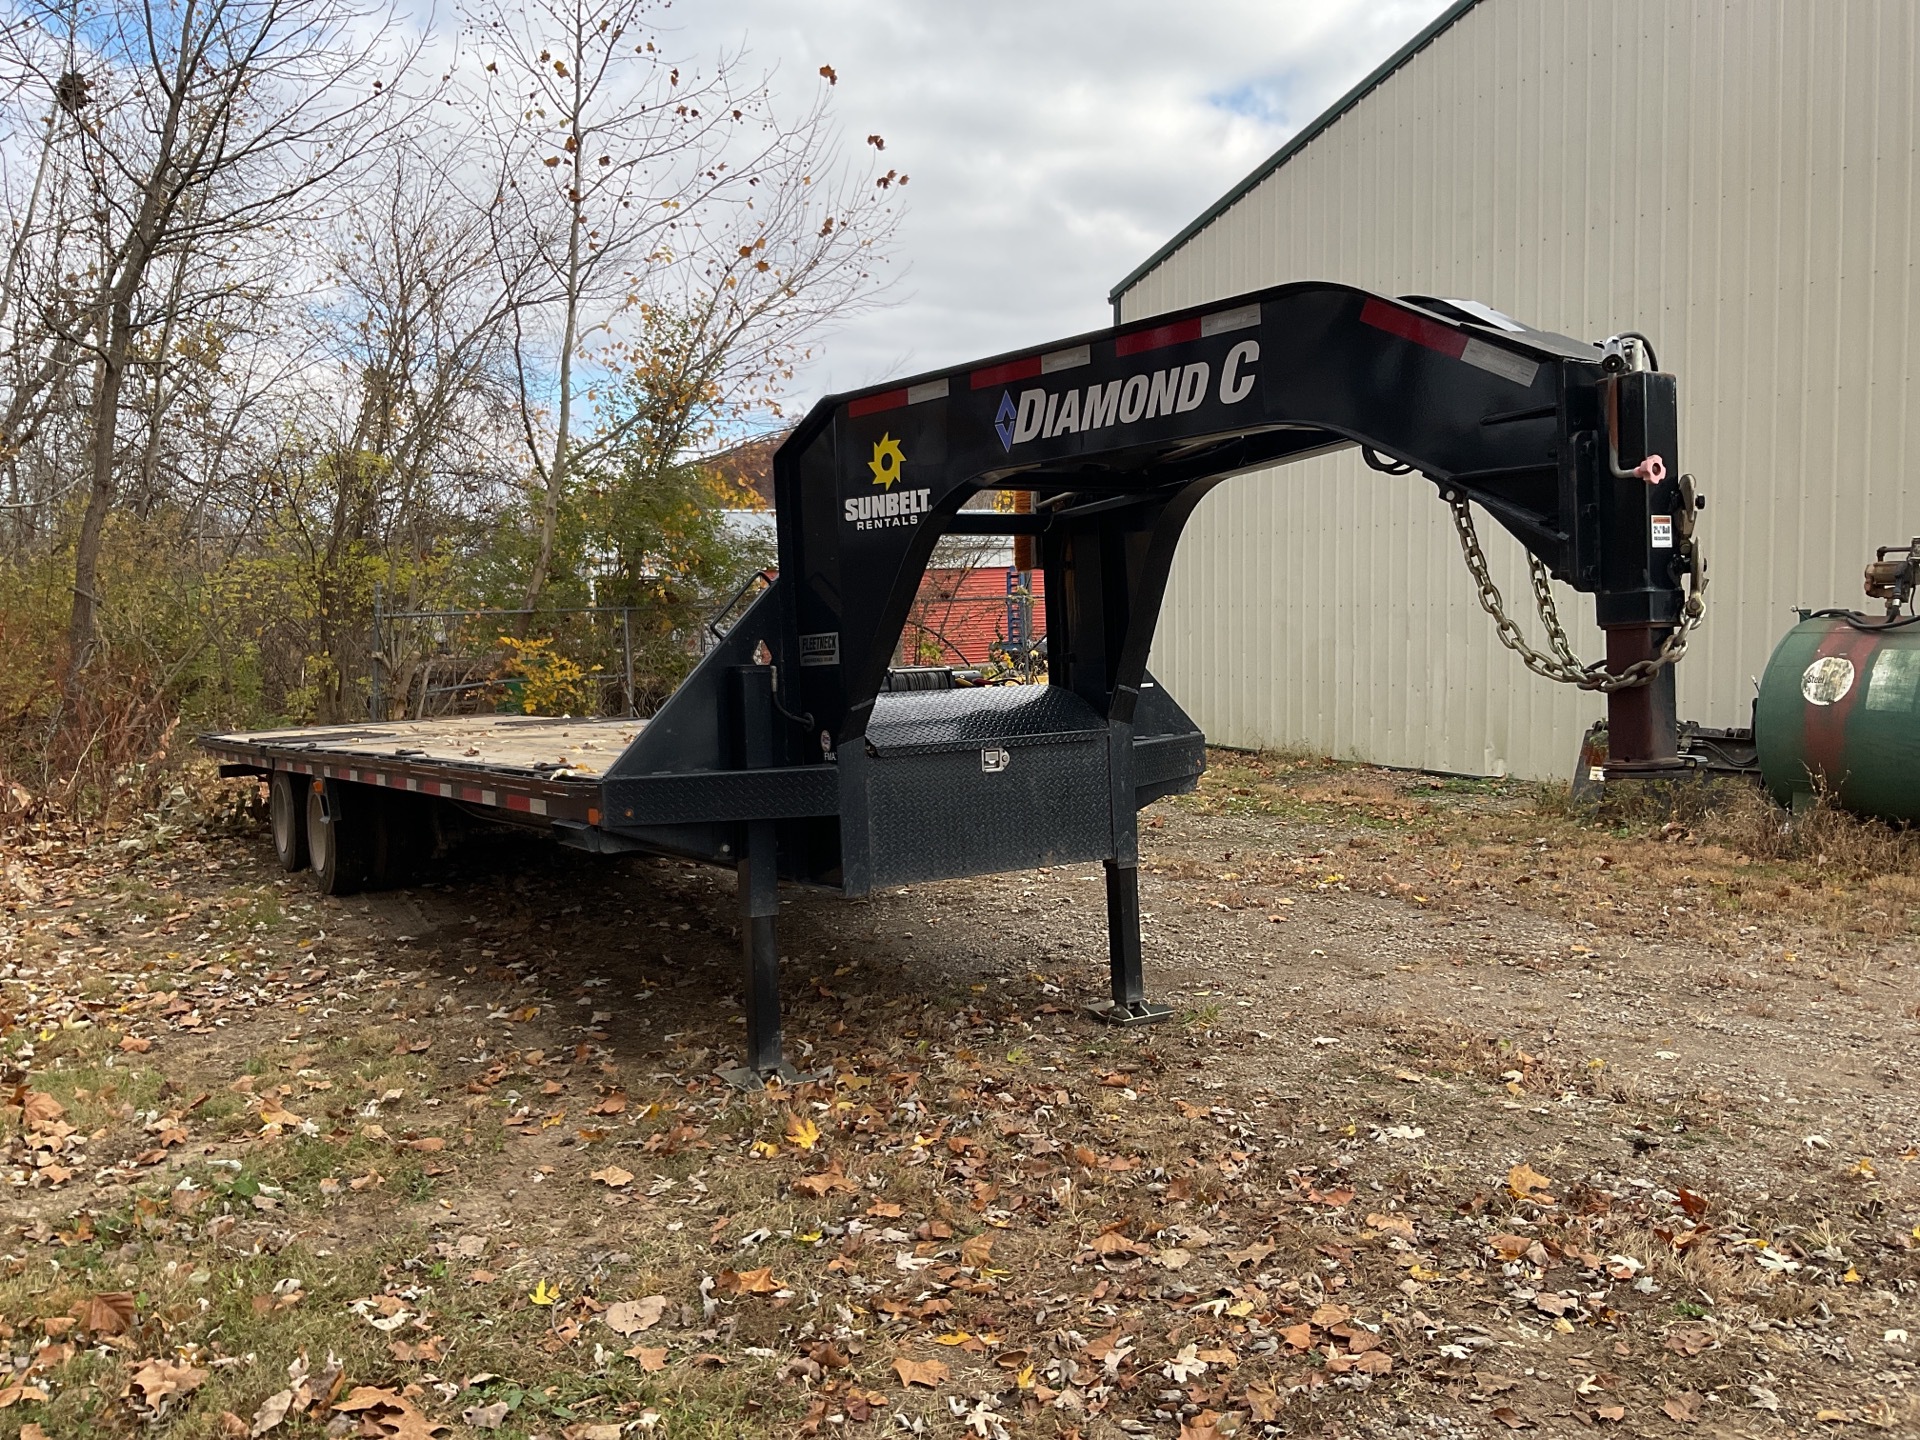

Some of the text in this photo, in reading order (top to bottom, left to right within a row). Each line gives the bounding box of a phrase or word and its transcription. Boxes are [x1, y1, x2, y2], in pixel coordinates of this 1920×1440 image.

[1012, 340, 1260, 445] DIAMOND C
[856, 515, 918, 531] RENTALS
[803, 634, 837, 650] FLEETNECK
